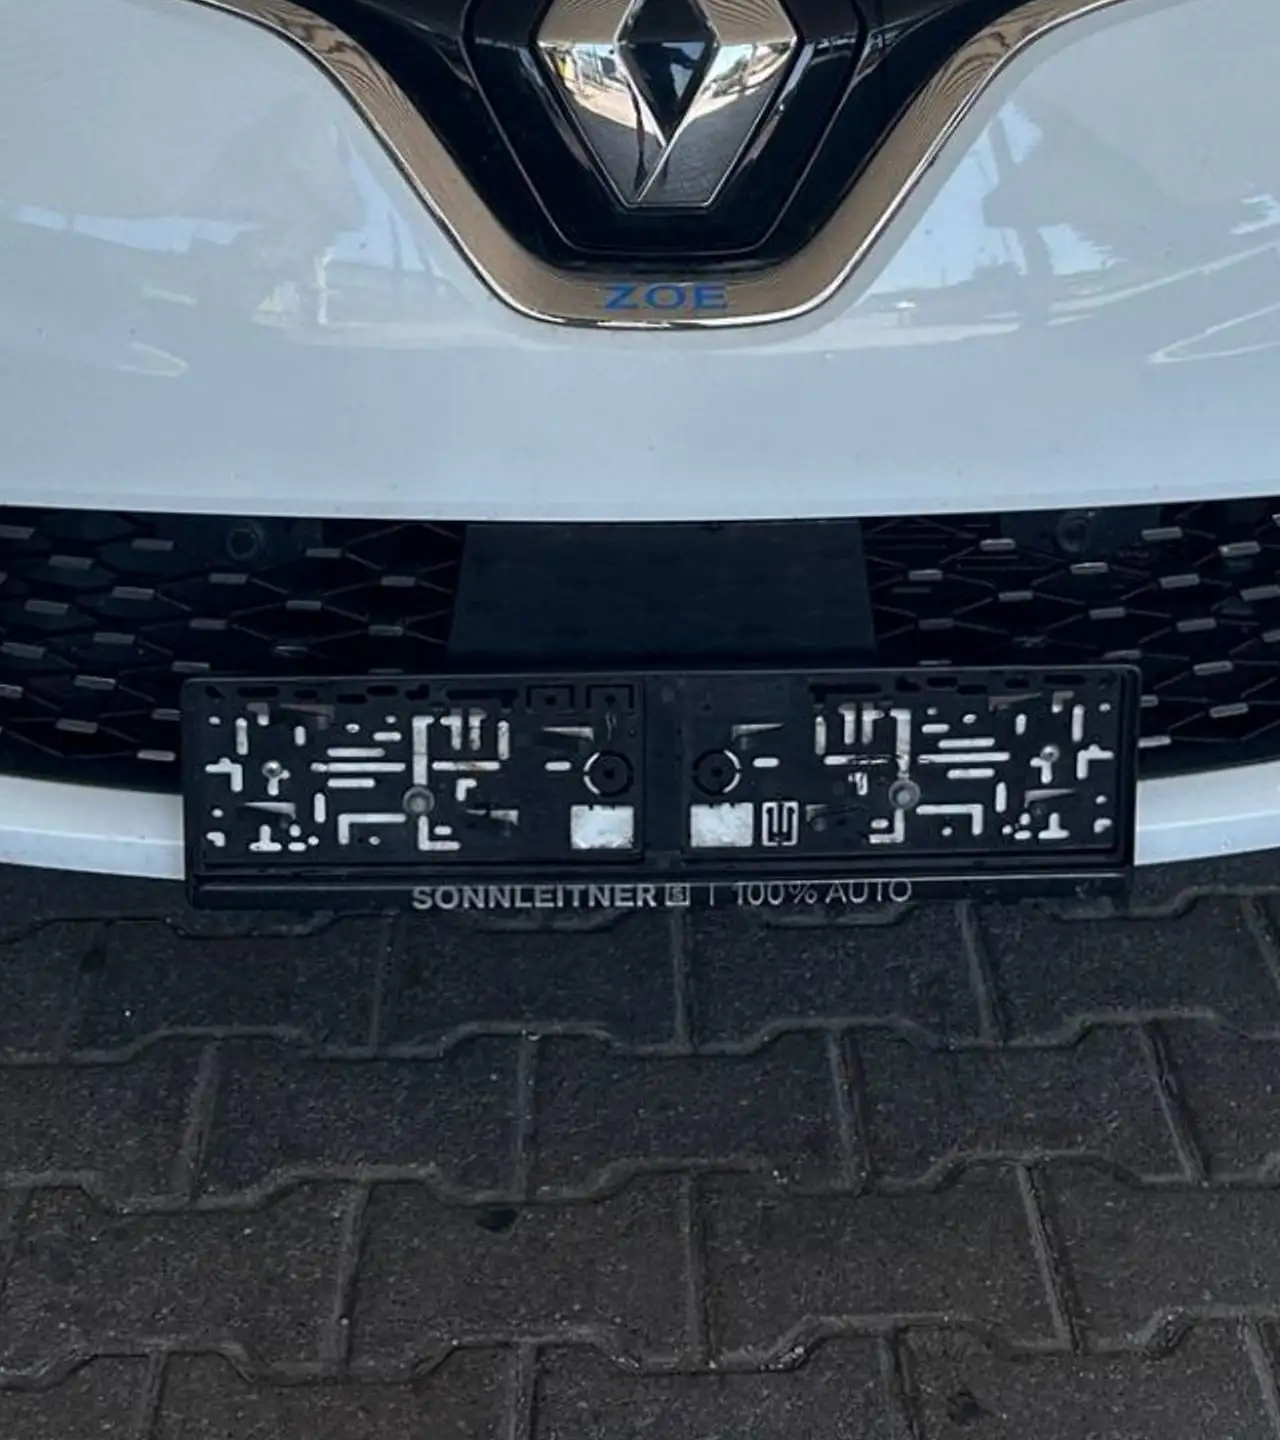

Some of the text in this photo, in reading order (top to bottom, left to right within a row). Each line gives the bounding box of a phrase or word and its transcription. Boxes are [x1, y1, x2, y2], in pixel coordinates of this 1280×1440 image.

[605, 283, 726, 310] ZOE
[412, 884, 657, 909] SONNLEITNER
[733, 880, 818, 906] 100%
[825, 878, 912, 903] AUTO
